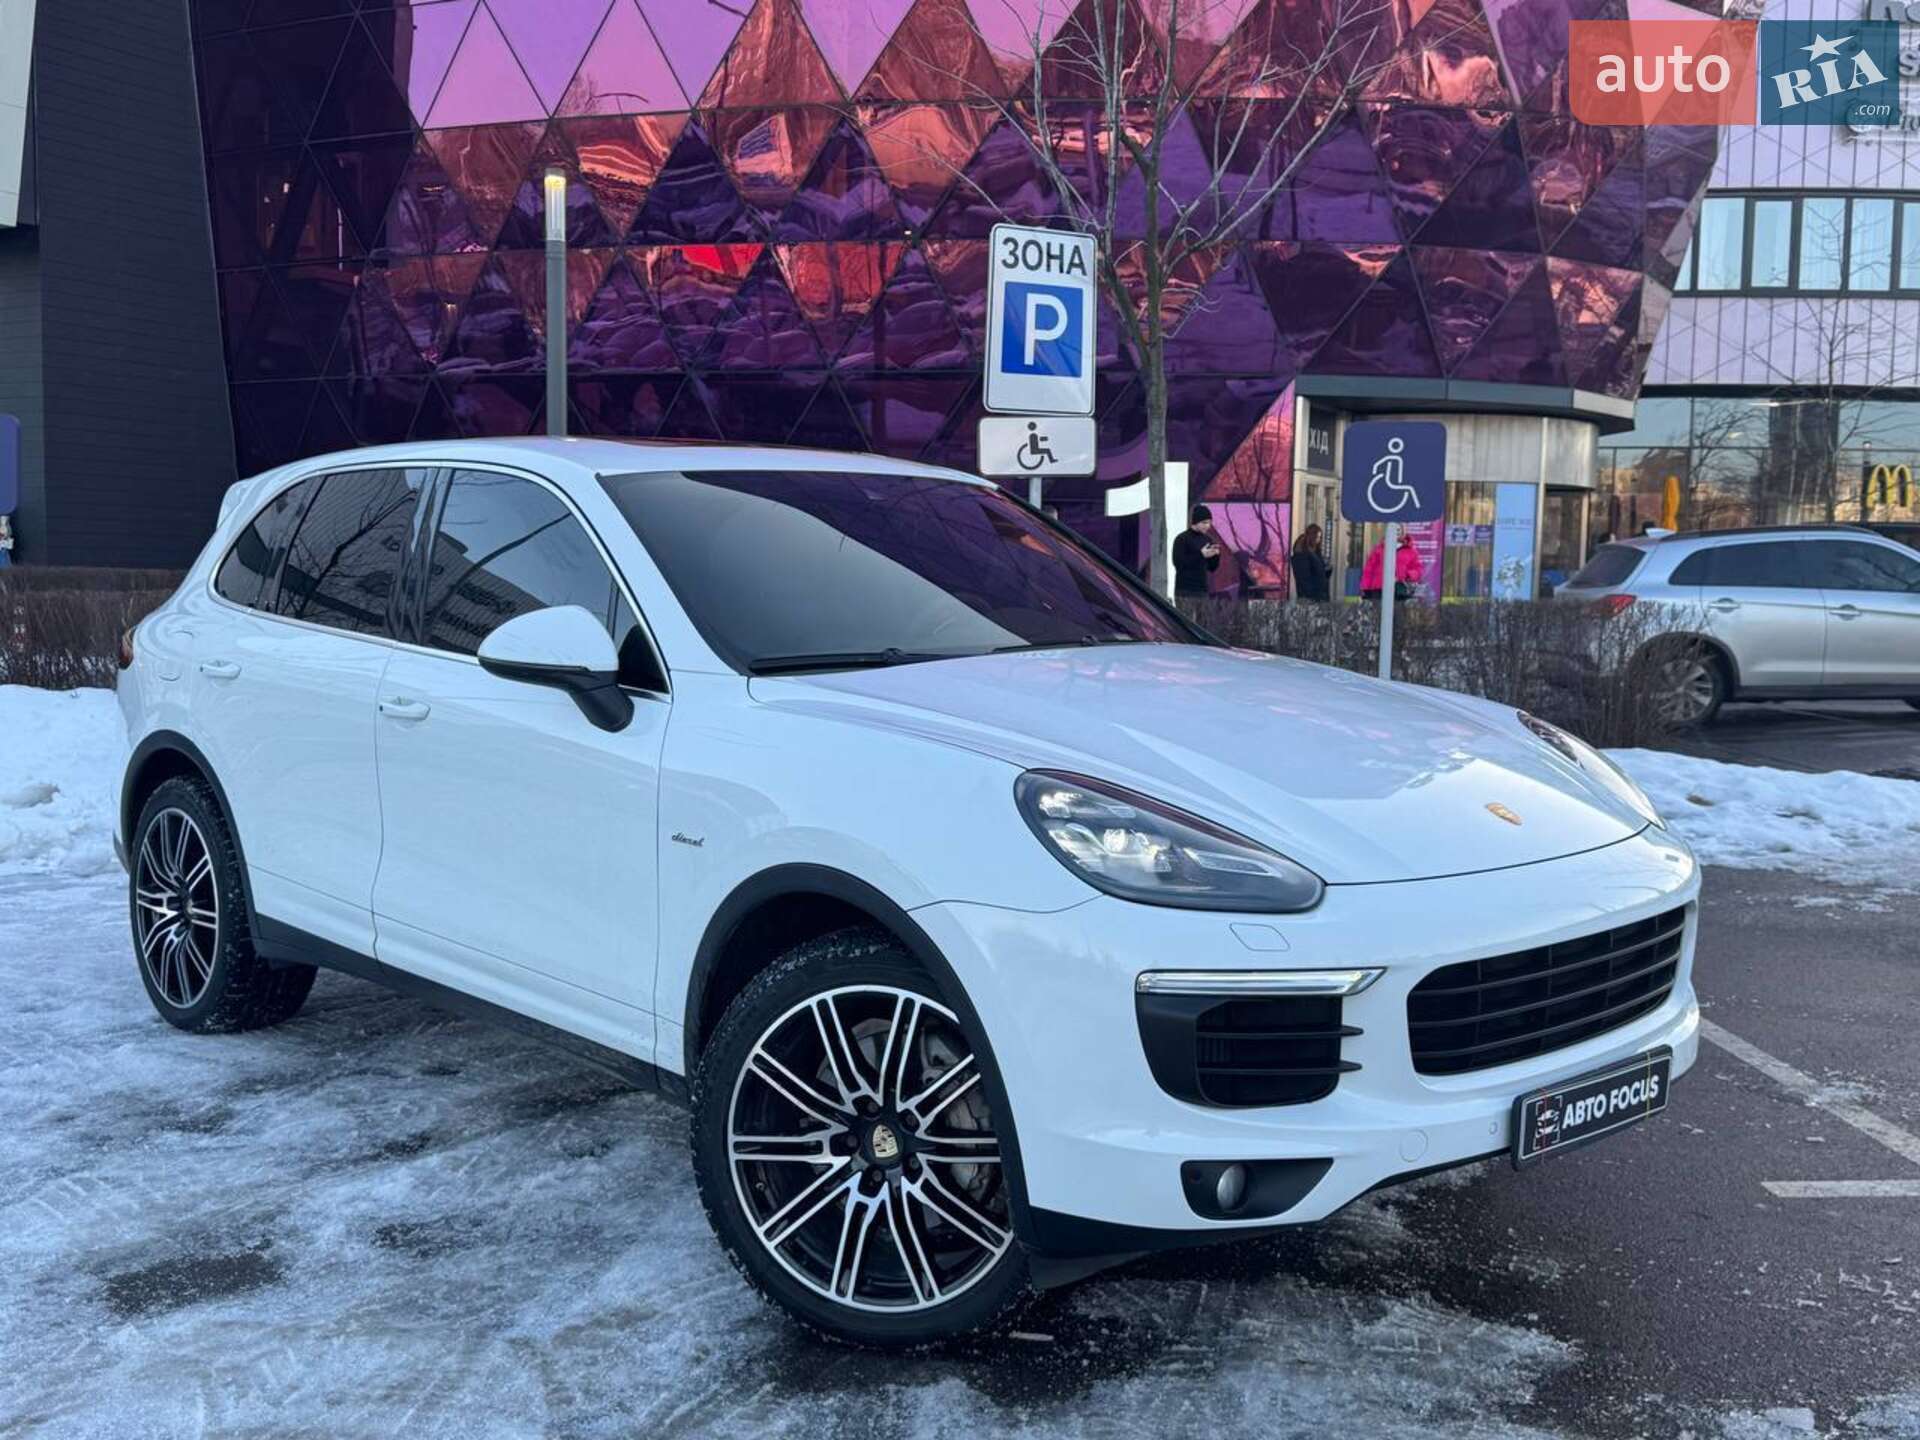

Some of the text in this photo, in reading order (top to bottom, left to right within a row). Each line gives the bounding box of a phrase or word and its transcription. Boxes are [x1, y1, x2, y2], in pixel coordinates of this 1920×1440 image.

[1001, 237, 1087, 276] ЗОНА
[1024, 293, 1068, 366] P
[1563, 1075, 1660, 1130] АВТО FOCUS
